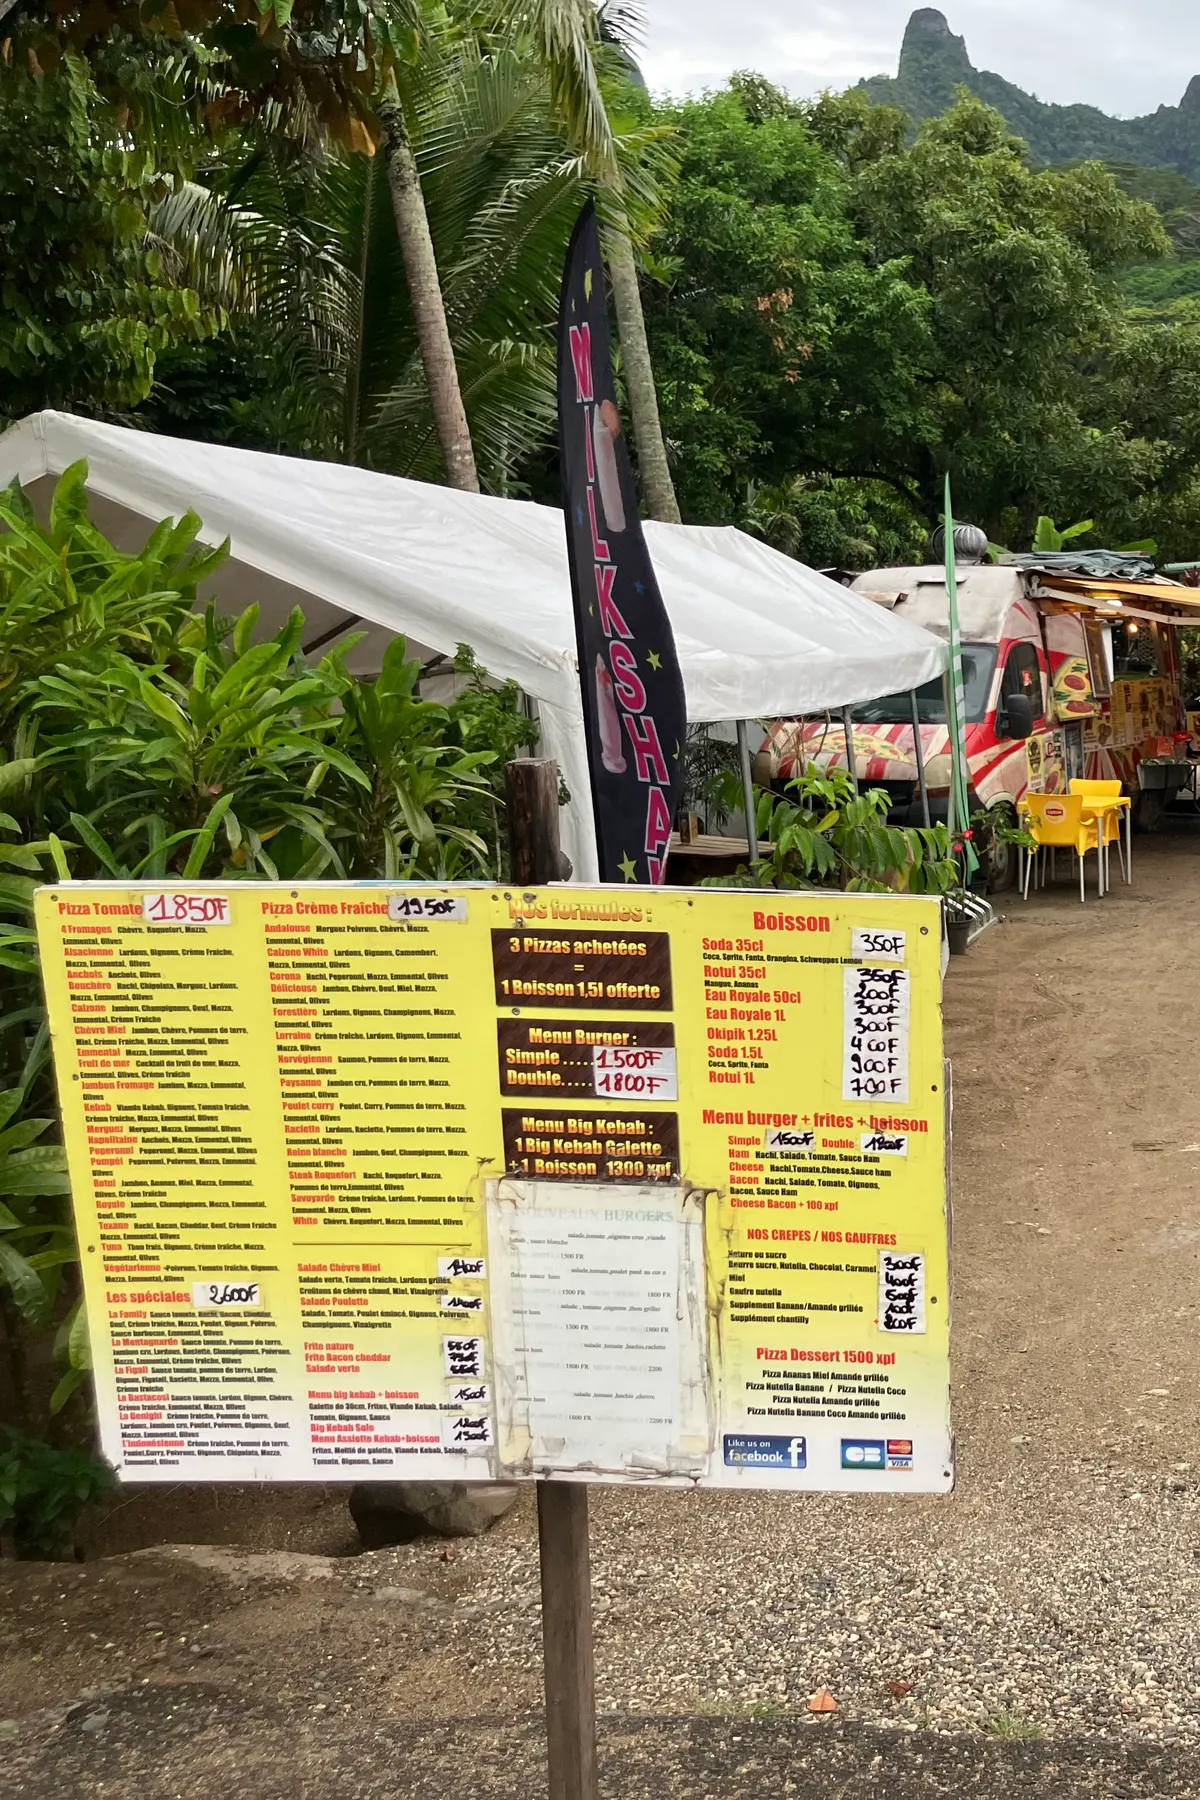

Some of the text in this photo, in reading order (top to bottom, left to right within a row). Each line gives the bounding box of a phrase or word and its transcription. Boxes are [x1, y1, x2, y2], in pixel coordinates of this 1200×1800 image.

[59, 903, 143, 915] Pizza Tomate
[149, 895, 227, 921] 1850F
[262, 902, 388, 914] Pizza Crème Fraîche
[398, 898, 455, 915] 1950F
[509, 900, 642, 922] Nos formules
[265, 924, 310, 932] Andalouse
[753, 912, 830, 932] Boisson
[61, 925, 111, 934] 4 Fromages
[510, 938, 647, 956] 3 Pizzas achetées
[703, 938, 763, 951] Soda 35cl
[860, 934, 905, 953] 350F
[270, 972, 300, 980] Corona
[704, 965, 766, 979] Rotui 35cl
[501, 980, 509, 994] 1
[513, 980, 574, 997] Boisson
[607, 984, 660, 999] offerte
[705, 990, 801, 1003] Eau Royale 50cl
[274, 1008, 317, 1016] Forestière
[706, 1007, 785, 1021] Eau Royale 1L
[75, 1026, 126, 1034] Chèvre Miel
[707, 1028, 777, 1041] Okipik 1.25L
[529, 1028, 630, 1046] Menu Burger
[506, 1049, 560, 1066] Simple
[708, 1046, 763, 1059] Soda 1.5L
[596, 1050, 663, 1069] 1500F
[280, 1079, 321, 1087] Paysanne
[598, 1073, 668, 1093] 1800F
[709, 1071, 755, 1083] Rotui 1L
[850, 1078, 901, 1096] 700F
[283, 1102, 309, 1110] Poulet
[522, 1117, 645, 1135] Menu Big Kebab
[703, 1110, 743, 1124] Menu
[747, 1111, 796, 1127] burger
[802, 1115, 810, 1123] +
[814, 1113, 853, 1128] frites
[870, 1115, 928, 1132] boisson
[515, 1138, 662, 1156] 1 Big Kebab Galette
[728, 1136, 760, 1146] Simple
[822, 1139, 854, 1148] Double
[729, 1149, 749, 1158] Ham
[864, 1155, 880, 1163] Ham
[509, 1160, 518, 1168] +
[521, 1159, 529, 1173] 1
[535, 1159, 596, 1175] Boisson
[606, 1161, 644, 1176] 1300
[729, 1163, 764, 1171] Cheese
[730, 1176, 759, 1184] Bacon
[731, 1199, 765, 1208] Cheese
[768, 1200, 796, 1209] Bacon
[806, 1201, 822, 1210] 100
[824, 1201, 838, 1211] xpf
[605, 1210, 674, 1222] BURGERS
[748, 1229, 768, 1241] NOS
[772, 1230, 811, 1241] CREPES
[822, 1231, 842, 1243] NOS
[845, 1233, 896, 1245] GAUFFRES
[298, 1264, 327, 1272] Salade
[330, 1264, 360, 1272] Chèvre
[106, 1291, 190, 1303] Les spéciales
[757, 1348, 895, 1365] Pizza Dessert 1500 xpf
[763, 1370, 781, 1378] Pizza
[783, 1371, 811, 1380] Ananas
[813, 1371, 829, 1380] Miel
[831, 1372, 862, 1381] Amande
[308, 1391, 332, 1399] Menu
[334, 1391, 347, 1400] big
[350, 1391, 375, 1399] kebab
[385, 1391, 419, 1399] boisson
[311, 1424, 374, 1433] Big Kebab Solo
[729, 1449, 783, 1462] facebook
